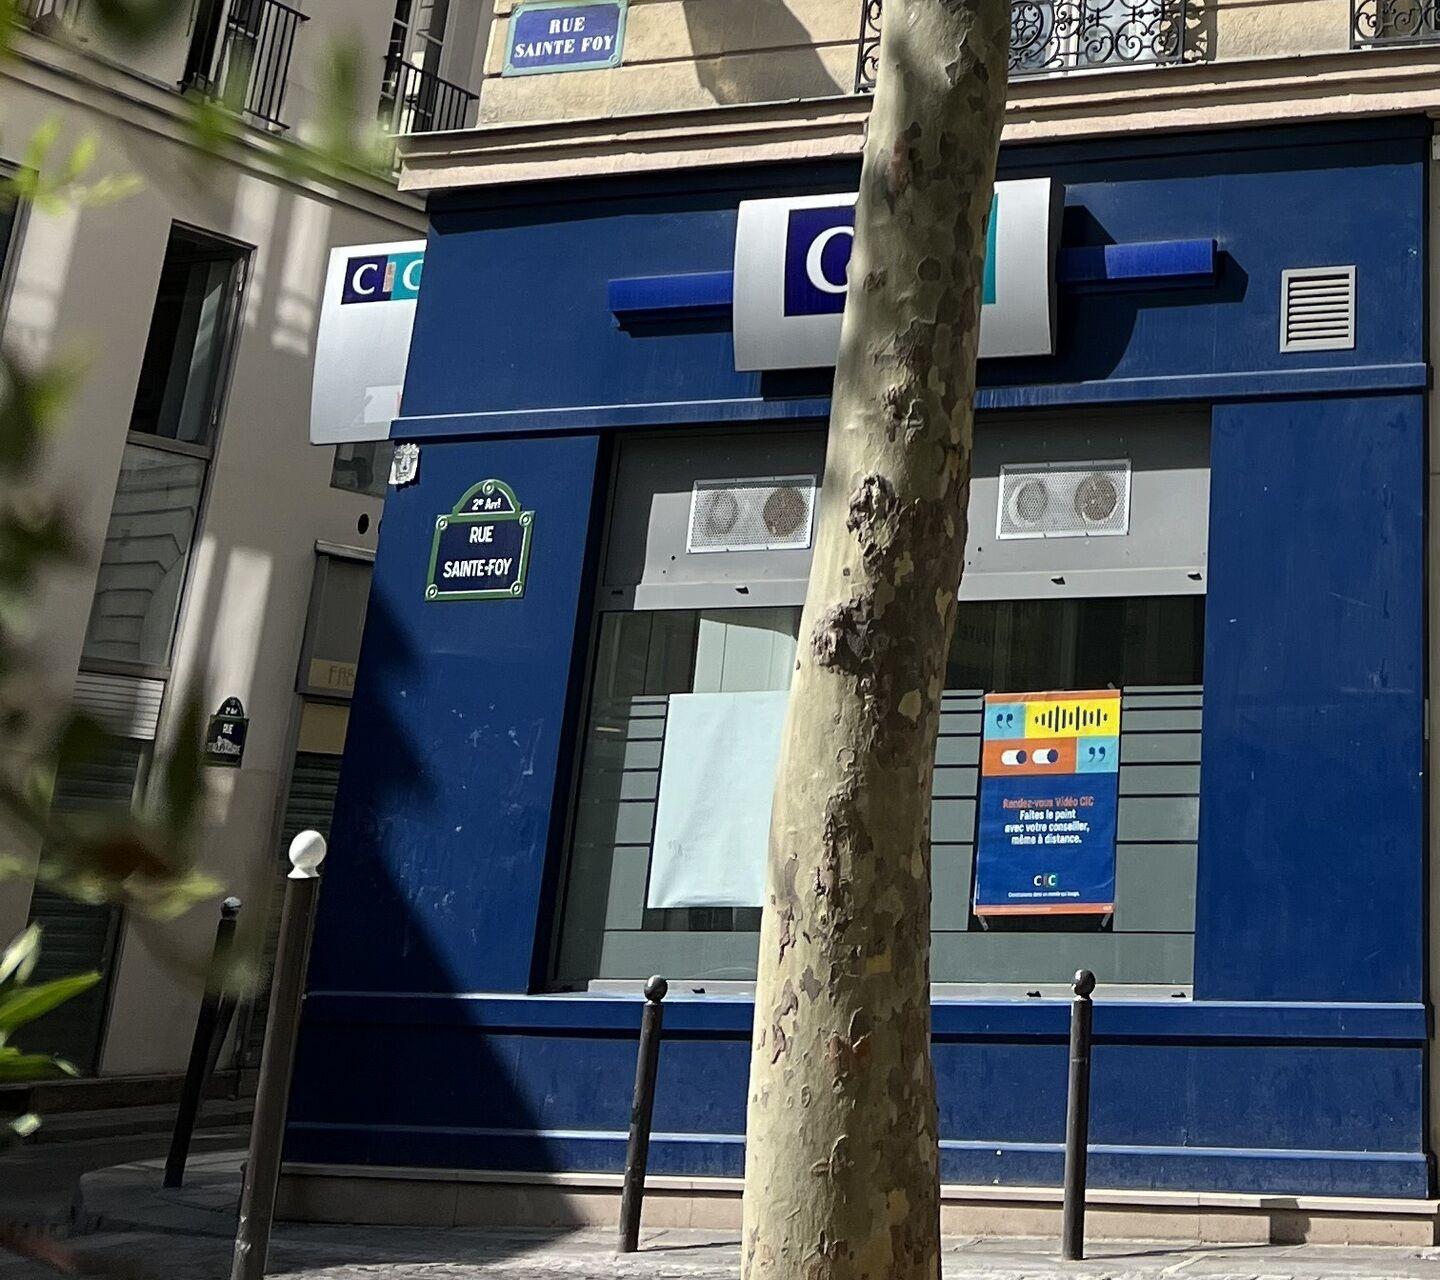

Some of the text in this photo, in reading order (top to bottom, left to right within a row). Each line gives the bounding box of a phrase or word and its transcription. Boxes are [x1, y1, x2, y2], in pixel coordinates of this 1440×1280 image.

[549, 17, 586, 34] RUE
[514, 35, 614, 58] SAINTE FOY
[469, 526, 494, 543] RUE
[443, 558, 512, 578] SAINTE-FOY
[1054, 796, 1078, 807] Vidéo
[1079, 795, 1095, 807] CIC
[1019, 809, 1076, 821] Faites le point
[1004, 821, 1090, 833] avec votre conseiller,
[1011, 834, 1036, 845] même
[1044, 833, 1082, 844] distance.
[1033, 874, 1056, 887] CIC
